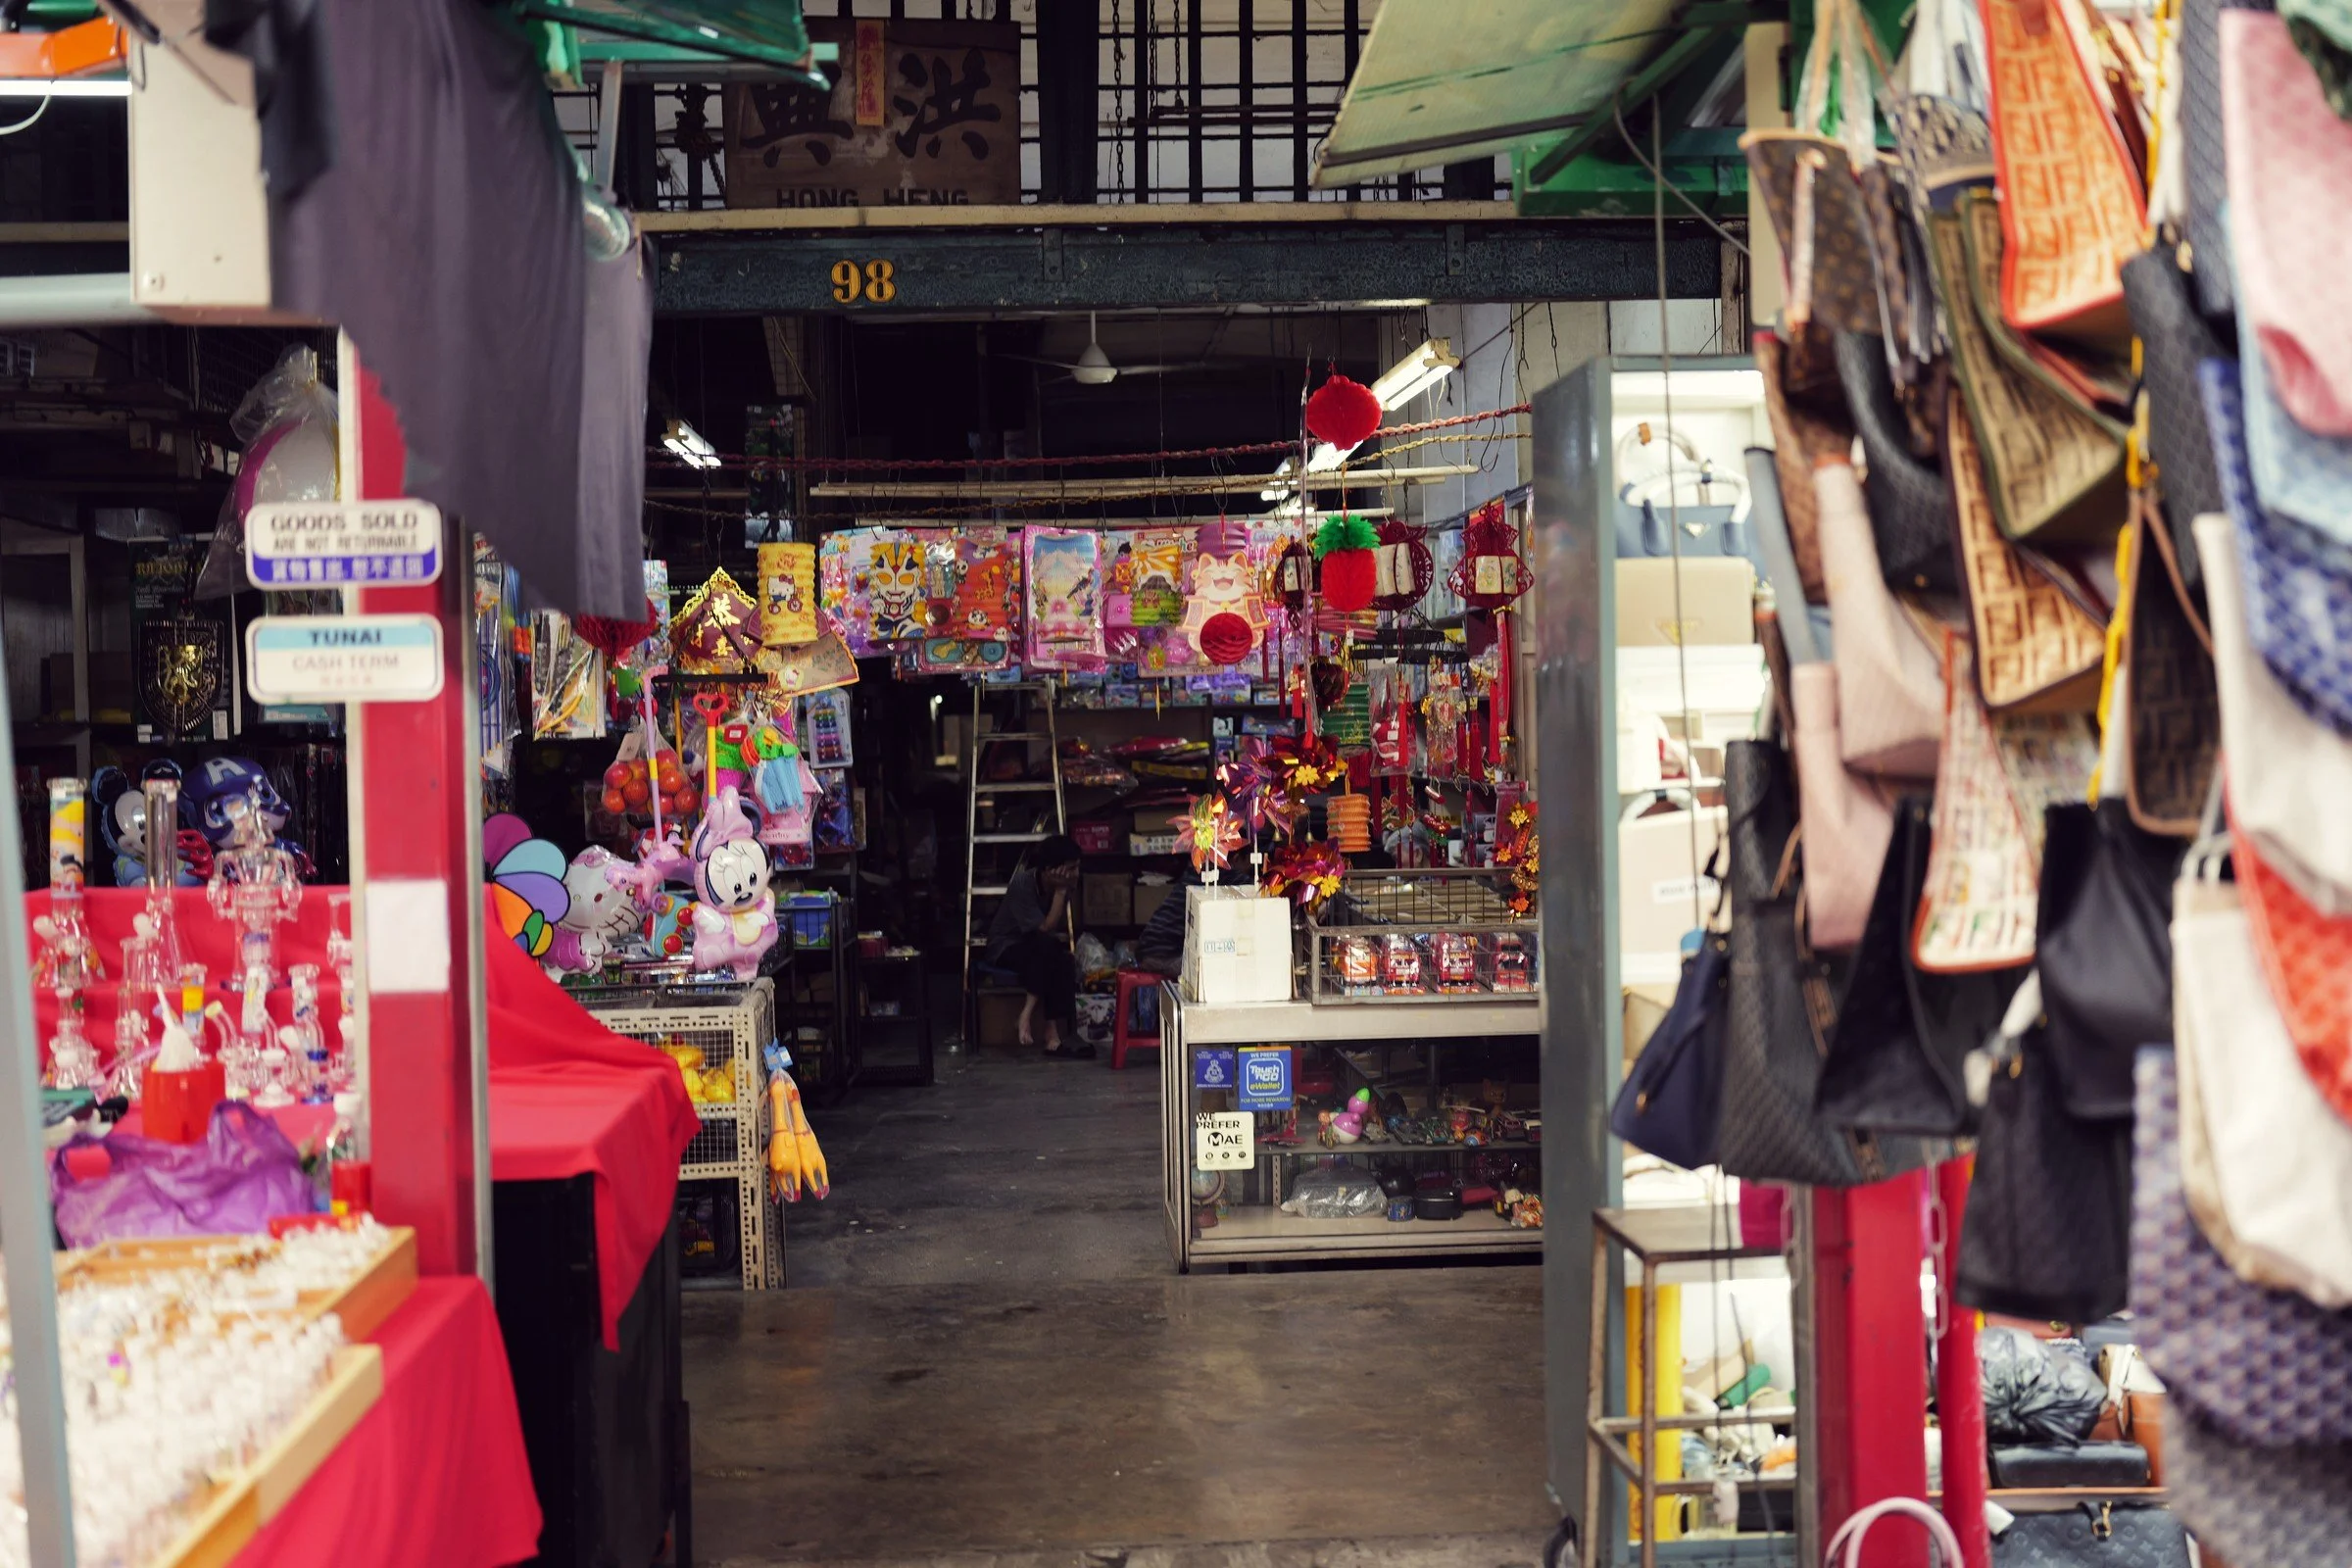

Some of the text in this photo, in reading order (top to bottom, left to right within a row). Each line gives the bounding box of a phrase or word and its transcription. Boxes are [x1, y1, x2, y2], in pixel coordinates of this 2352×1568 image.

[830, 258, 897, 304] 98
[270, 511, 417, 531] GOODS SOLD
[306, 536, 329, 551] NOT
[309, 628, 382, 647] TUNAI
[292, 653, 400, 671] CASH TERM
[205, 757, 247, 787] A
[1197, 1112, 1215, 1121] WE
[1197, 1120, 1241, 1129] PREFER
[1207, 1131, 1244, 1146] MAE
